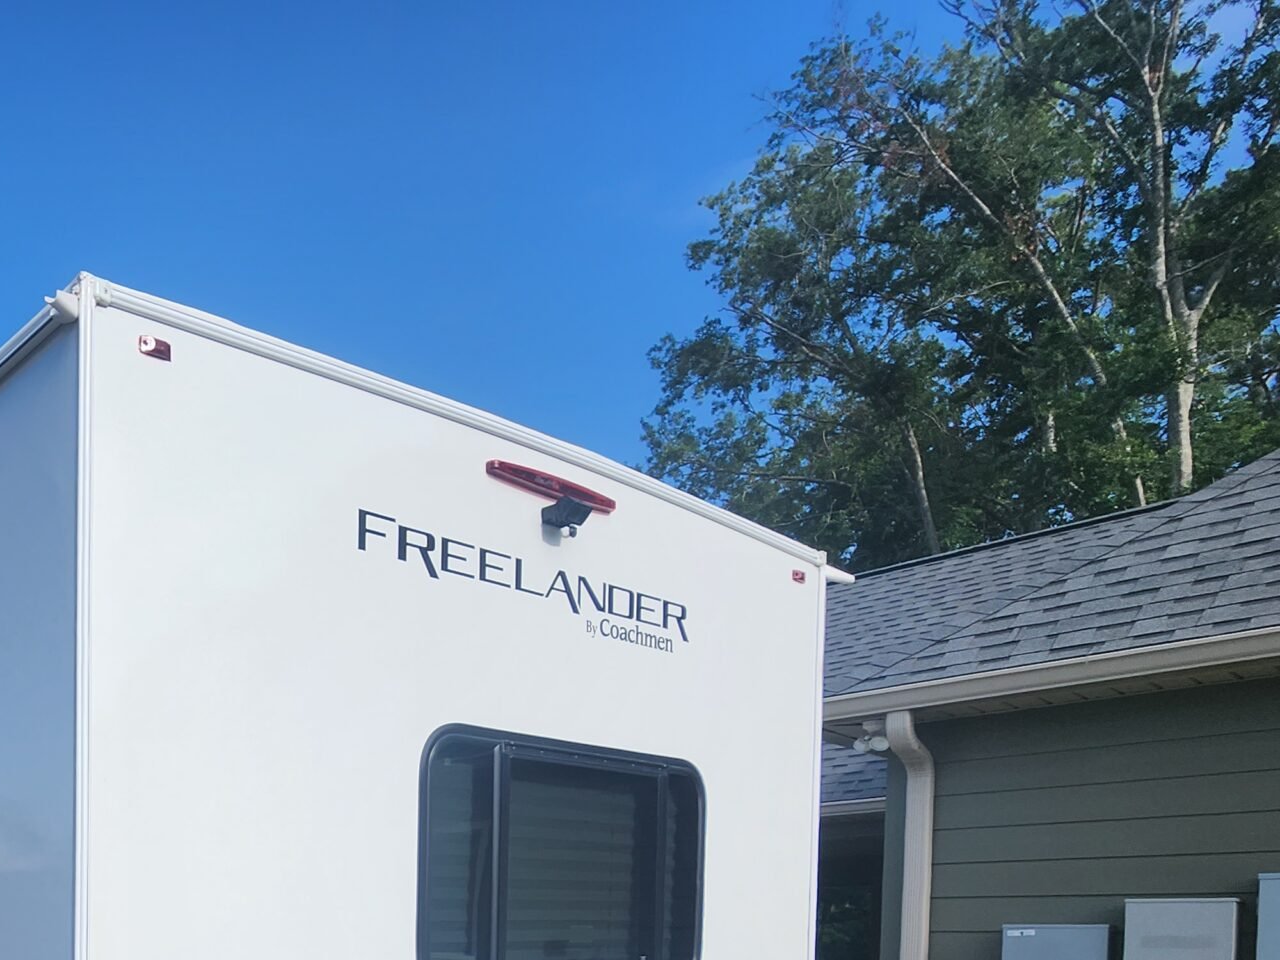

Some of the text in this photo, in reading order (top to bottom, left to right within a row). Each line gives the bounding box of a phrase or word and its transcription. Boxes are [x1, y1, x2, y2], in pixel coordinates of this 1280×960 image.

[358, 508, 689, 642] FREELANDER
[586, 618, 673, 653] By Coachmen
